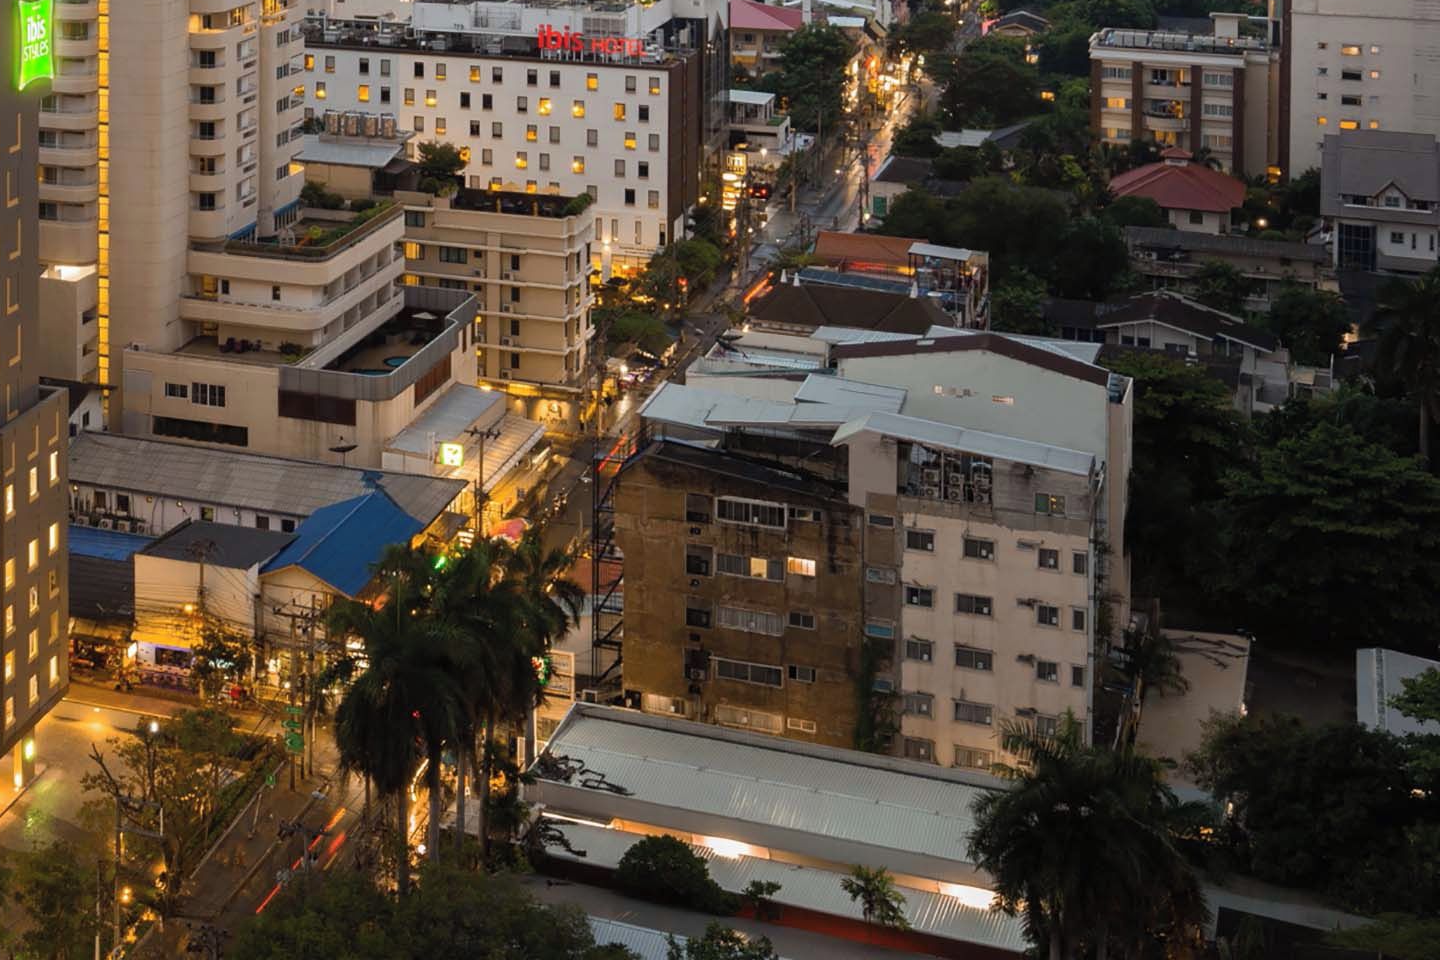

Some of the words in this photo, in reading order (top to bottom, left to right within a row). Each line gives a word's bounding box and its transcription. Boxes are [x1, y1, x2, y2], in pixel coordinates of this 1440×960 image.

[27, 14, 47, 43] ibis
[537, 24, 585, 52] ibis
[591, 37, 648, 57] HOTEL
